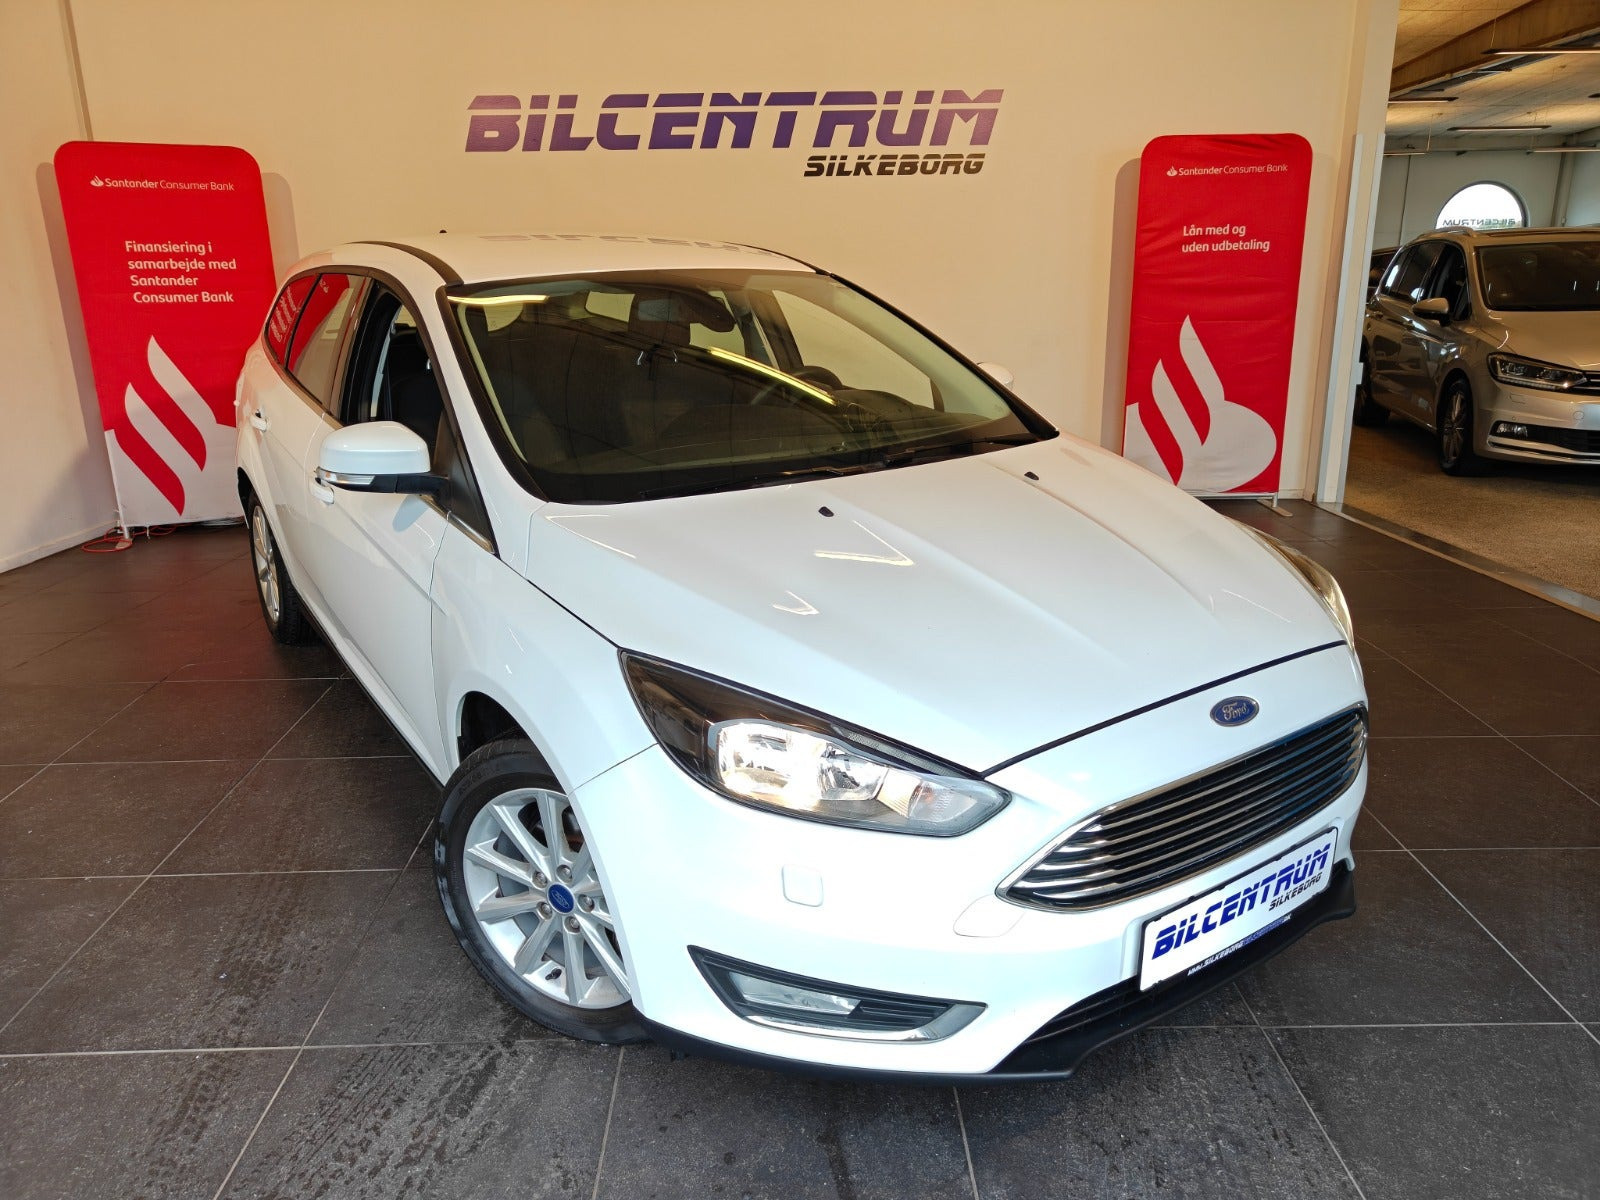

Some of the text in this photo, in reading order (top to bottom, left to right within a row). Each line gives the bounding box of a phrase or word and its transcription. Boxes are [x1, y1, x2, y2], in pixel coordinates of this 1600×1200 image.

[464, 88, 1005, 153] BILCENTRUM
[803, 153, 986, 178] SILKEBORG
[1178, 163, 1288, 176] Santander Consumer Bank
[104, 177, 235, 192] Santander Consumer Bank
[1183, 223, 1246, 237] Lån med og
[124, 240, 213, 256] Finansiering i
[1182, 238, 1271, 253] uden udbetaling
[127, 258, 238, 273] samarbejde med
[130, 274, 199, 287] Santander
[132, 291, 235, 303] Consumer Bank
[1268, 871, 1323, 911] SILKEBORG
[1151, 843, 1331, 960] BILCENTRUM
